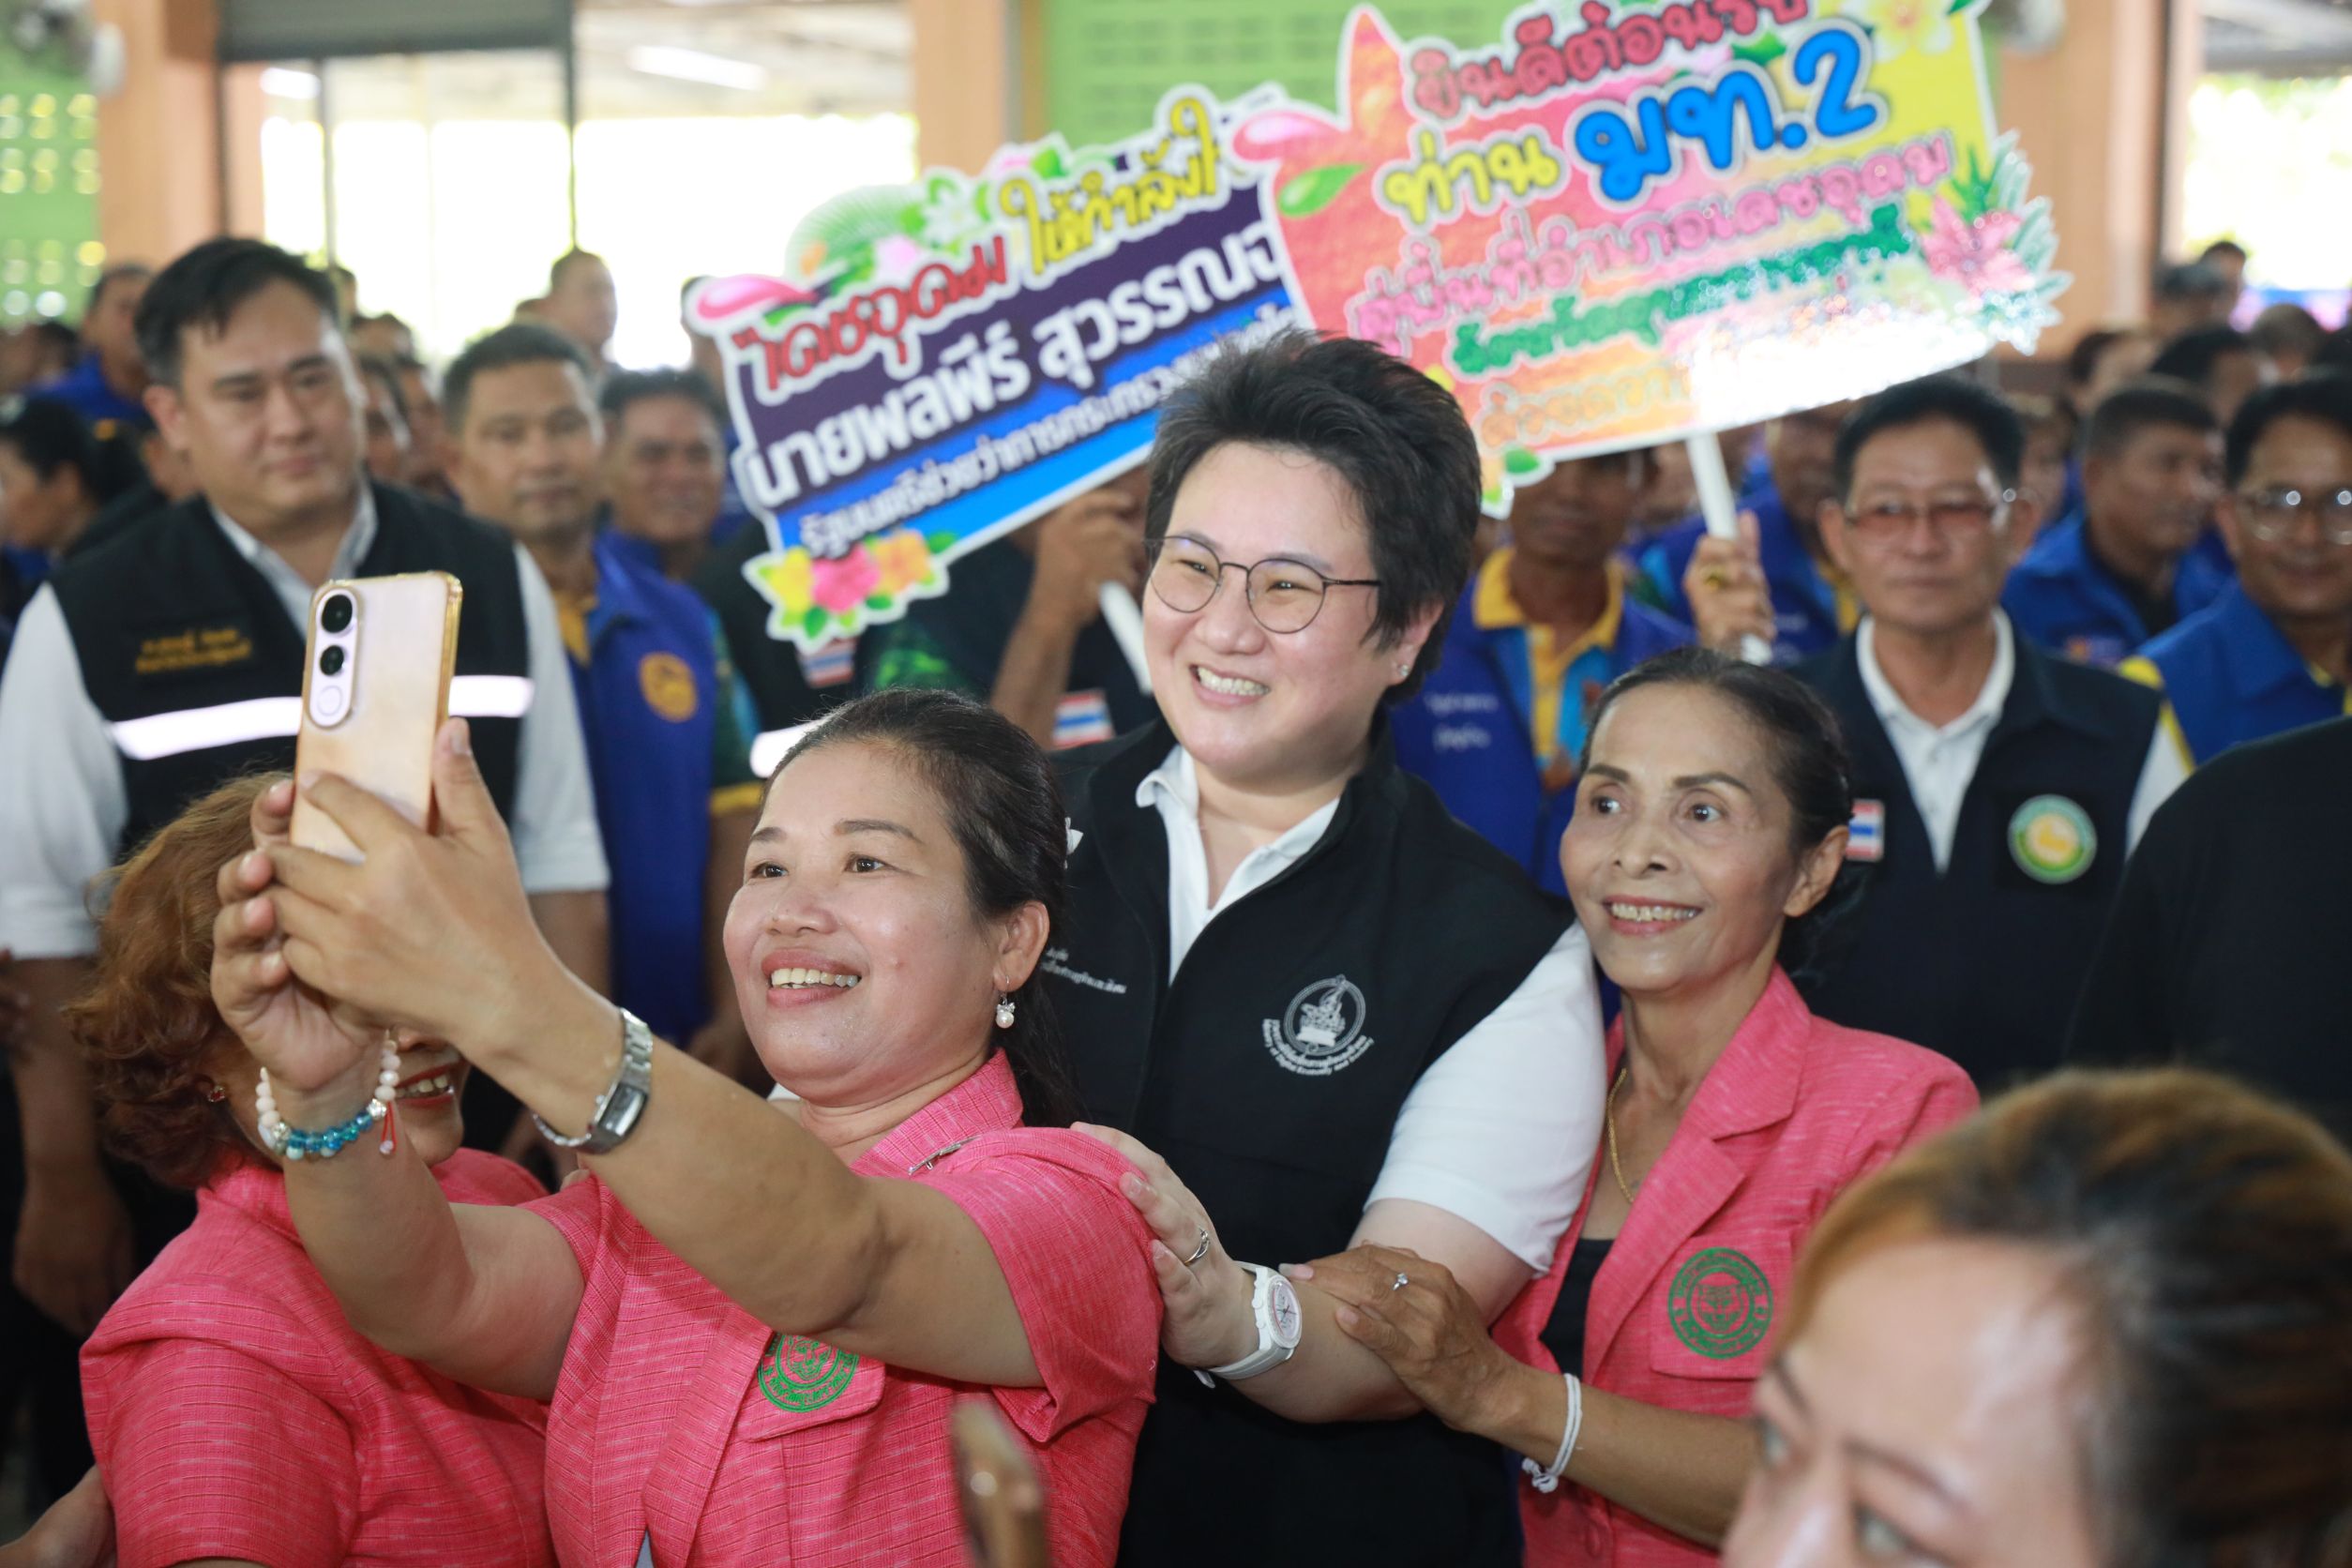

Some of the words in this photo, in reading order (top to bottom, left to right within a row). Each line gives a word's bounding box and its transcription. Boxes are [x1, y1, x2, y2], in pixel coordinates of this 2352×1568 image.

[1383, 128, 1560, 225] ท่าน
[1575, 28, 1878, 203] มท.2
[1411, 0, 1807, 119] ยินดีต้อนรบ
[999, 96, 1219, 276] ให้กำลังใ
[747, 320, 1032, 507] นายพลพีร์
